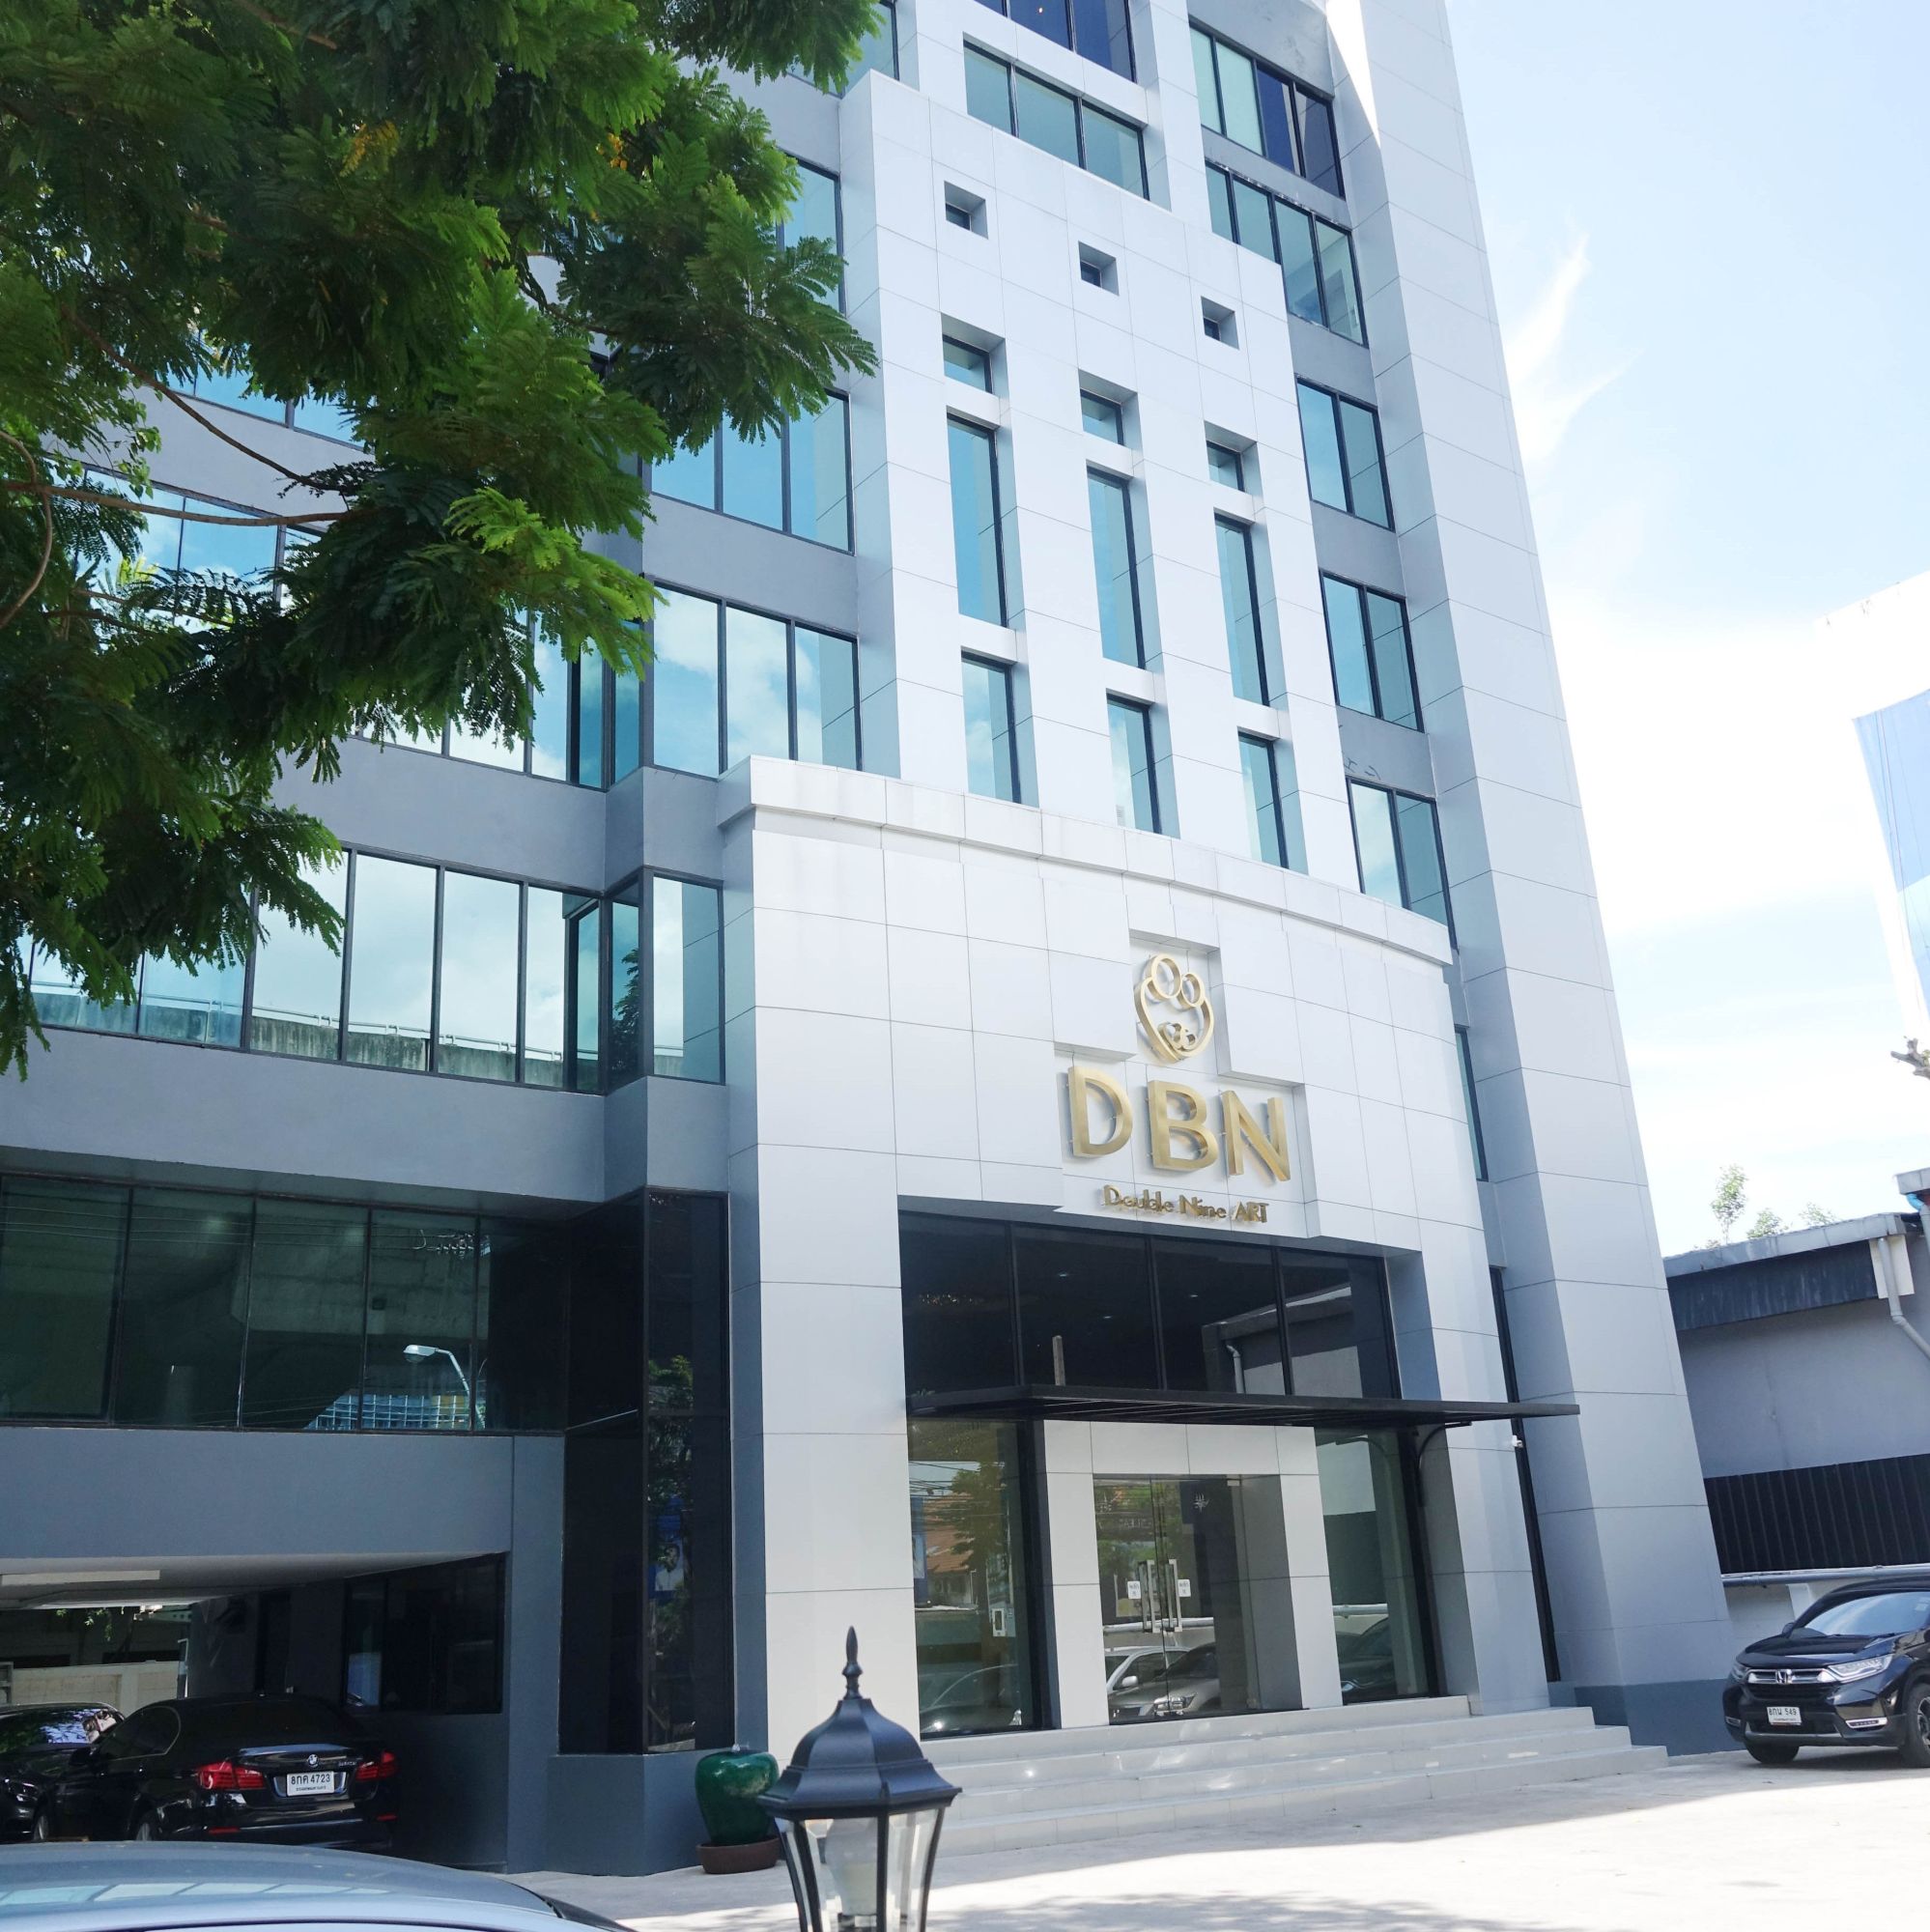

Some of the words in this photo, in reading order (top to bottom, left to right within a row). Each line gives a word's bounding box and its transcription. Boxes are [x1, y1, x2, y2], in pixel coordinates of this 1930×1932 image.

[1067, 1065, 1291, 1181] DBN
[1103, 1184, 1175, 1213] Double
[1178, 1194, 1228, 1219] Nine
[1231, 1200, 1270, 1224] ART
[310, 1774, 331, 1784] 4723
